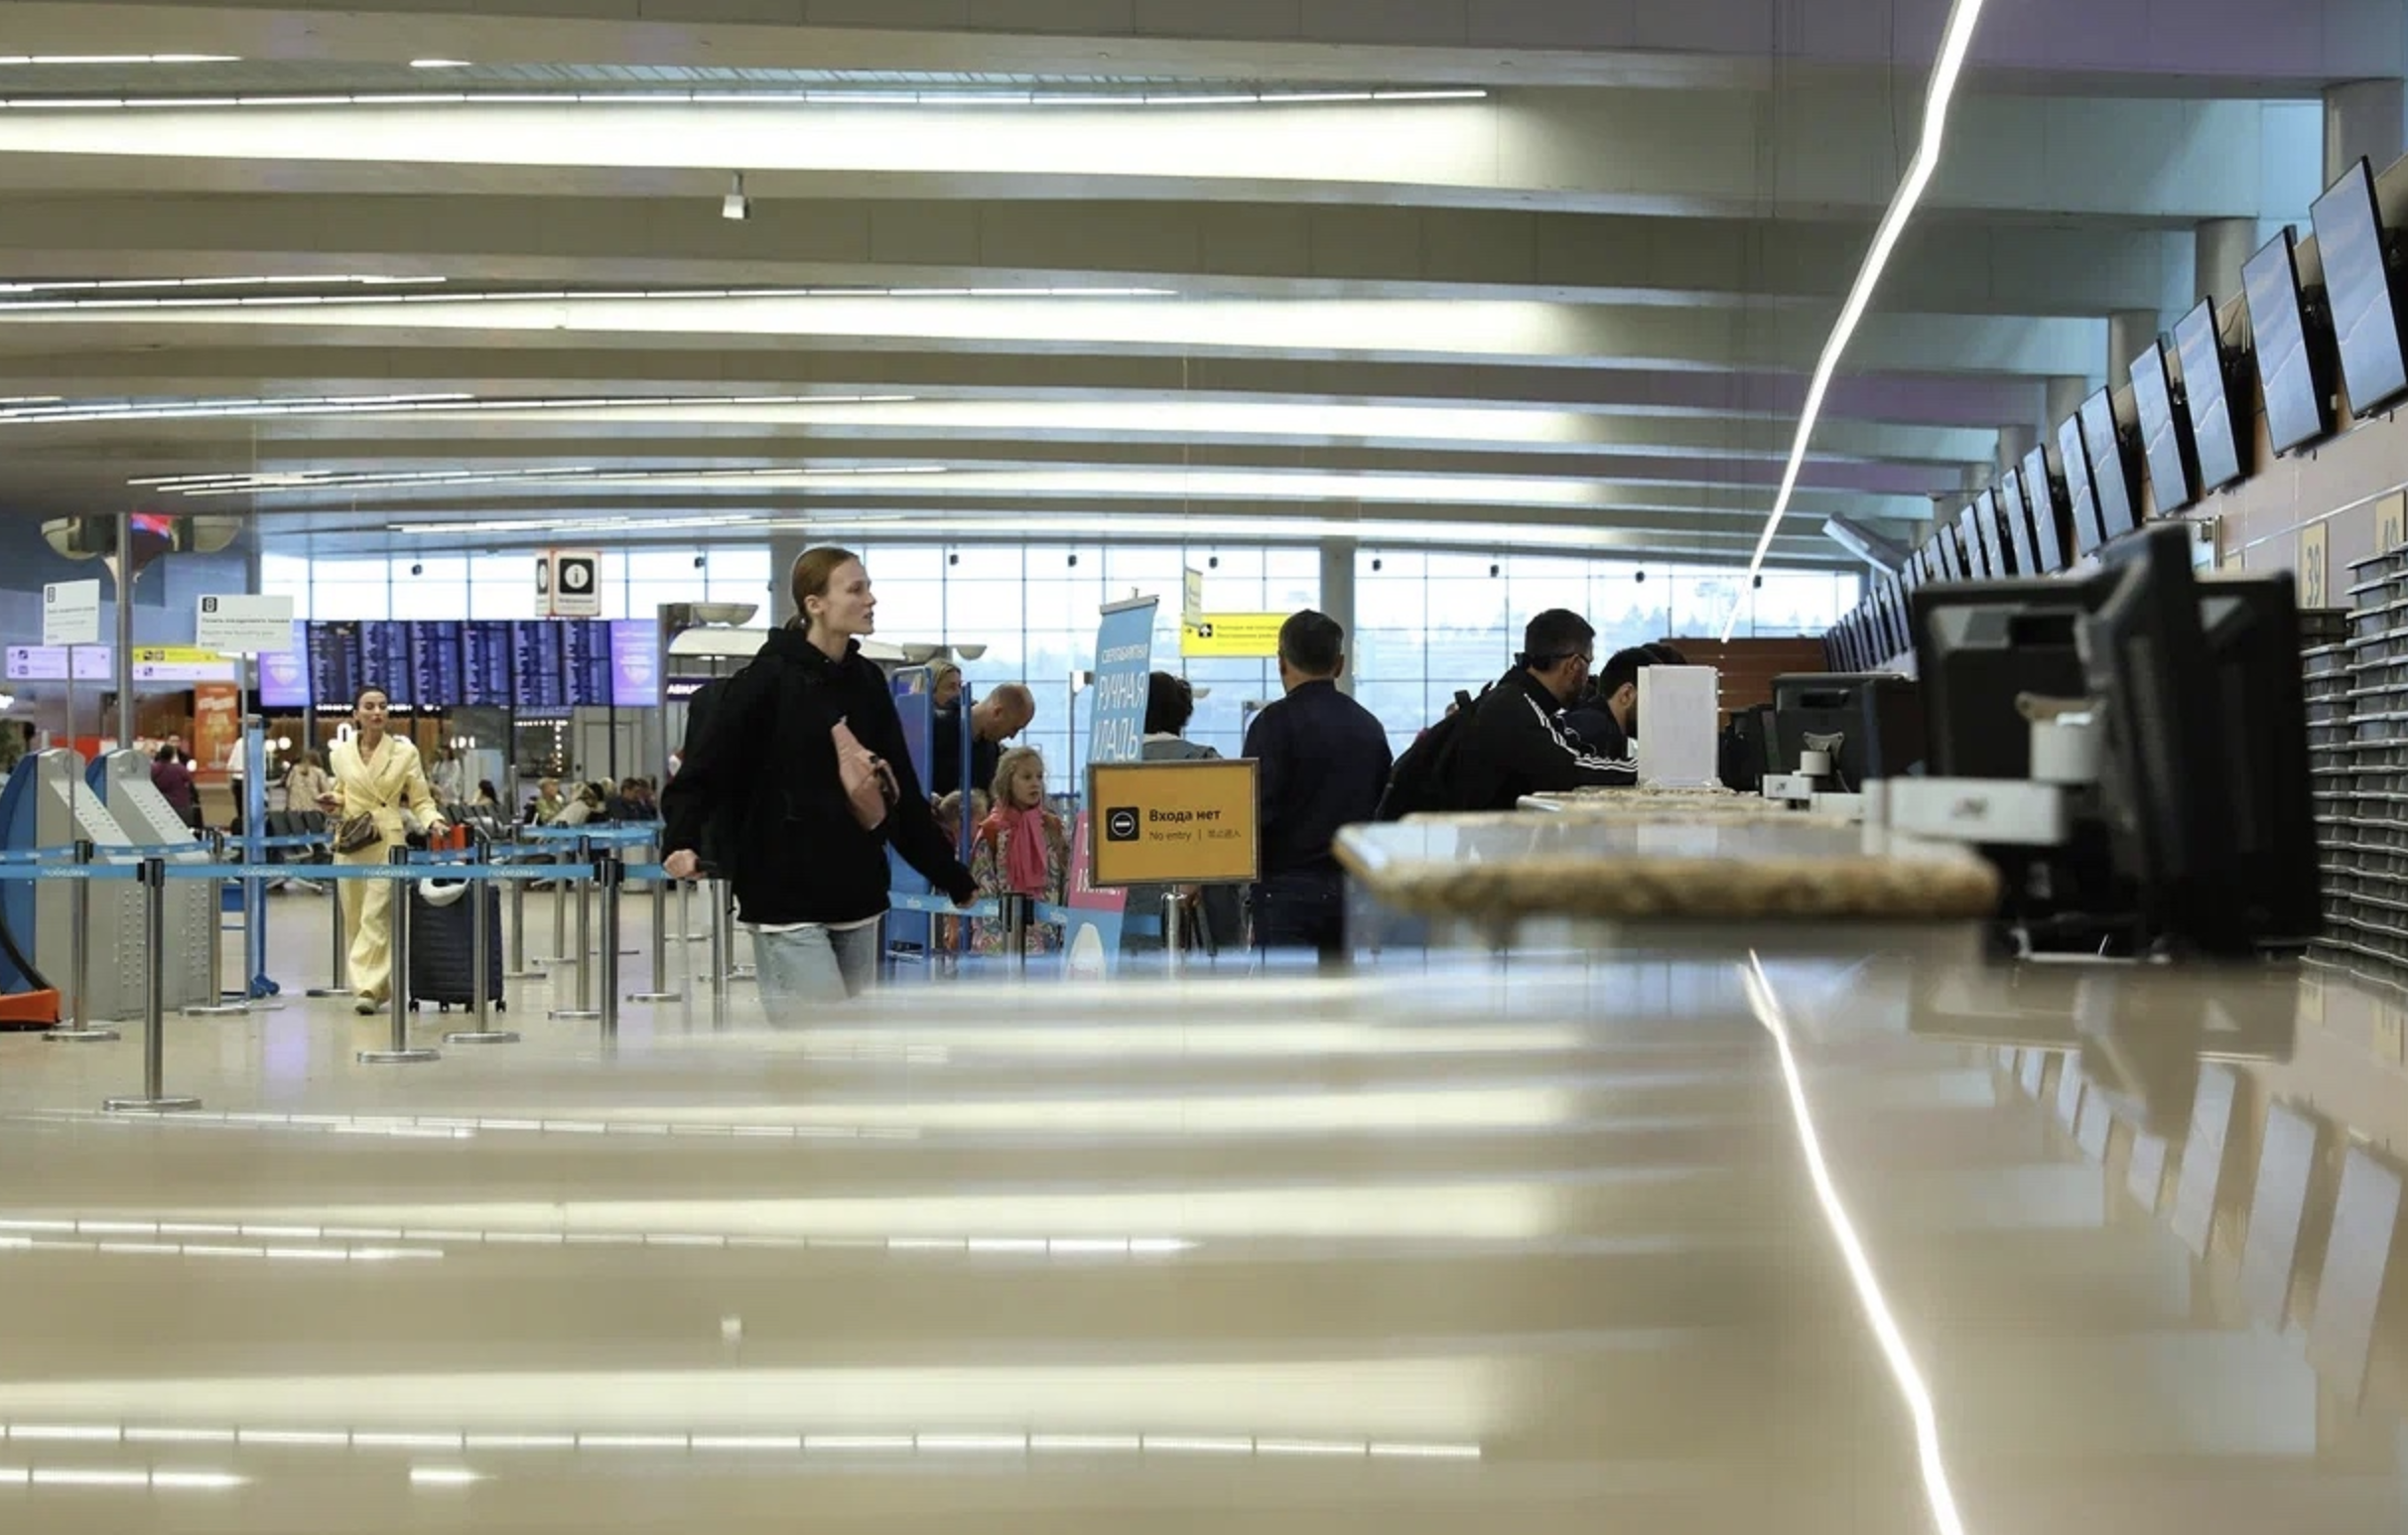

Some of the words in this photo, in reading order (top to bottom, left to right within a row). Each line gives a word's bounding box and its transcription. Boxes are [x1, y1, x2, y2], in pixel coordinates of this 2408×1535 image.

[2306, 543, 2322, 608] 39
[1097, 671, 1146, 711] РУЧНАЯ
[1092, 717, 1139, 763] КЛАДЬ
[1148, 831, 1163, 841] No
[1166, 830, 1191, 842] entry
[1149, 809, 1192, 823] Входа
[1196, 809, 1221, 820] нет
